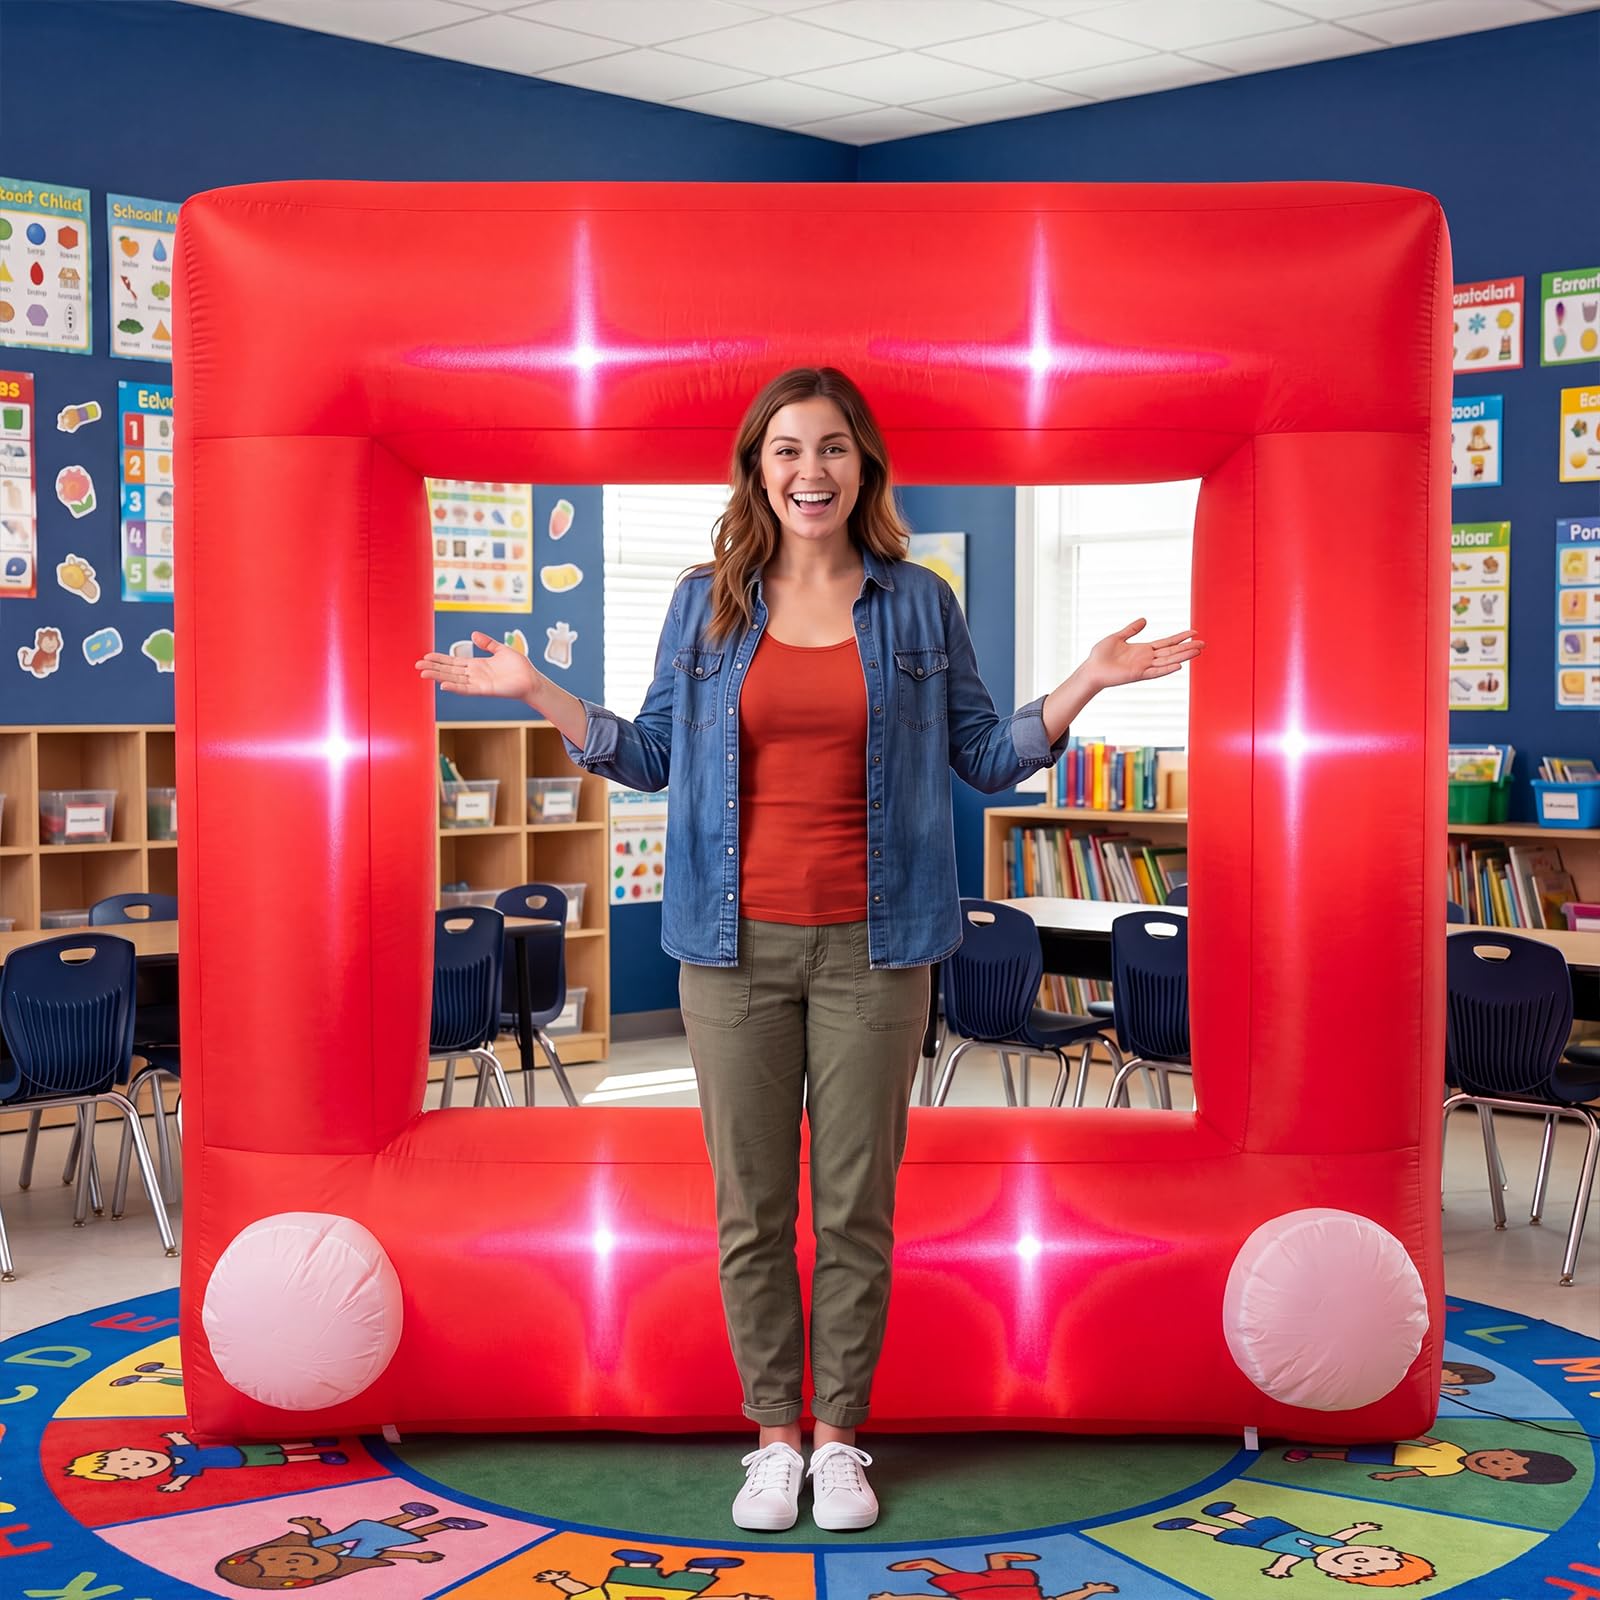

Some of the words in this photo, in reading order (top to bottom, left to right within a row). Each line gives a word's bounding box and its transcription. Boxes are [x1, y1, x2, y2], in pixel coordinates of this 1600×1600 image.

[129, 420, 139, 440] 1
[129, 455, 141, 477] 2
[129, 491, 142, 512] 3
[129, 525, 142, 548] 4
[129, 563, 142, 584] 5
